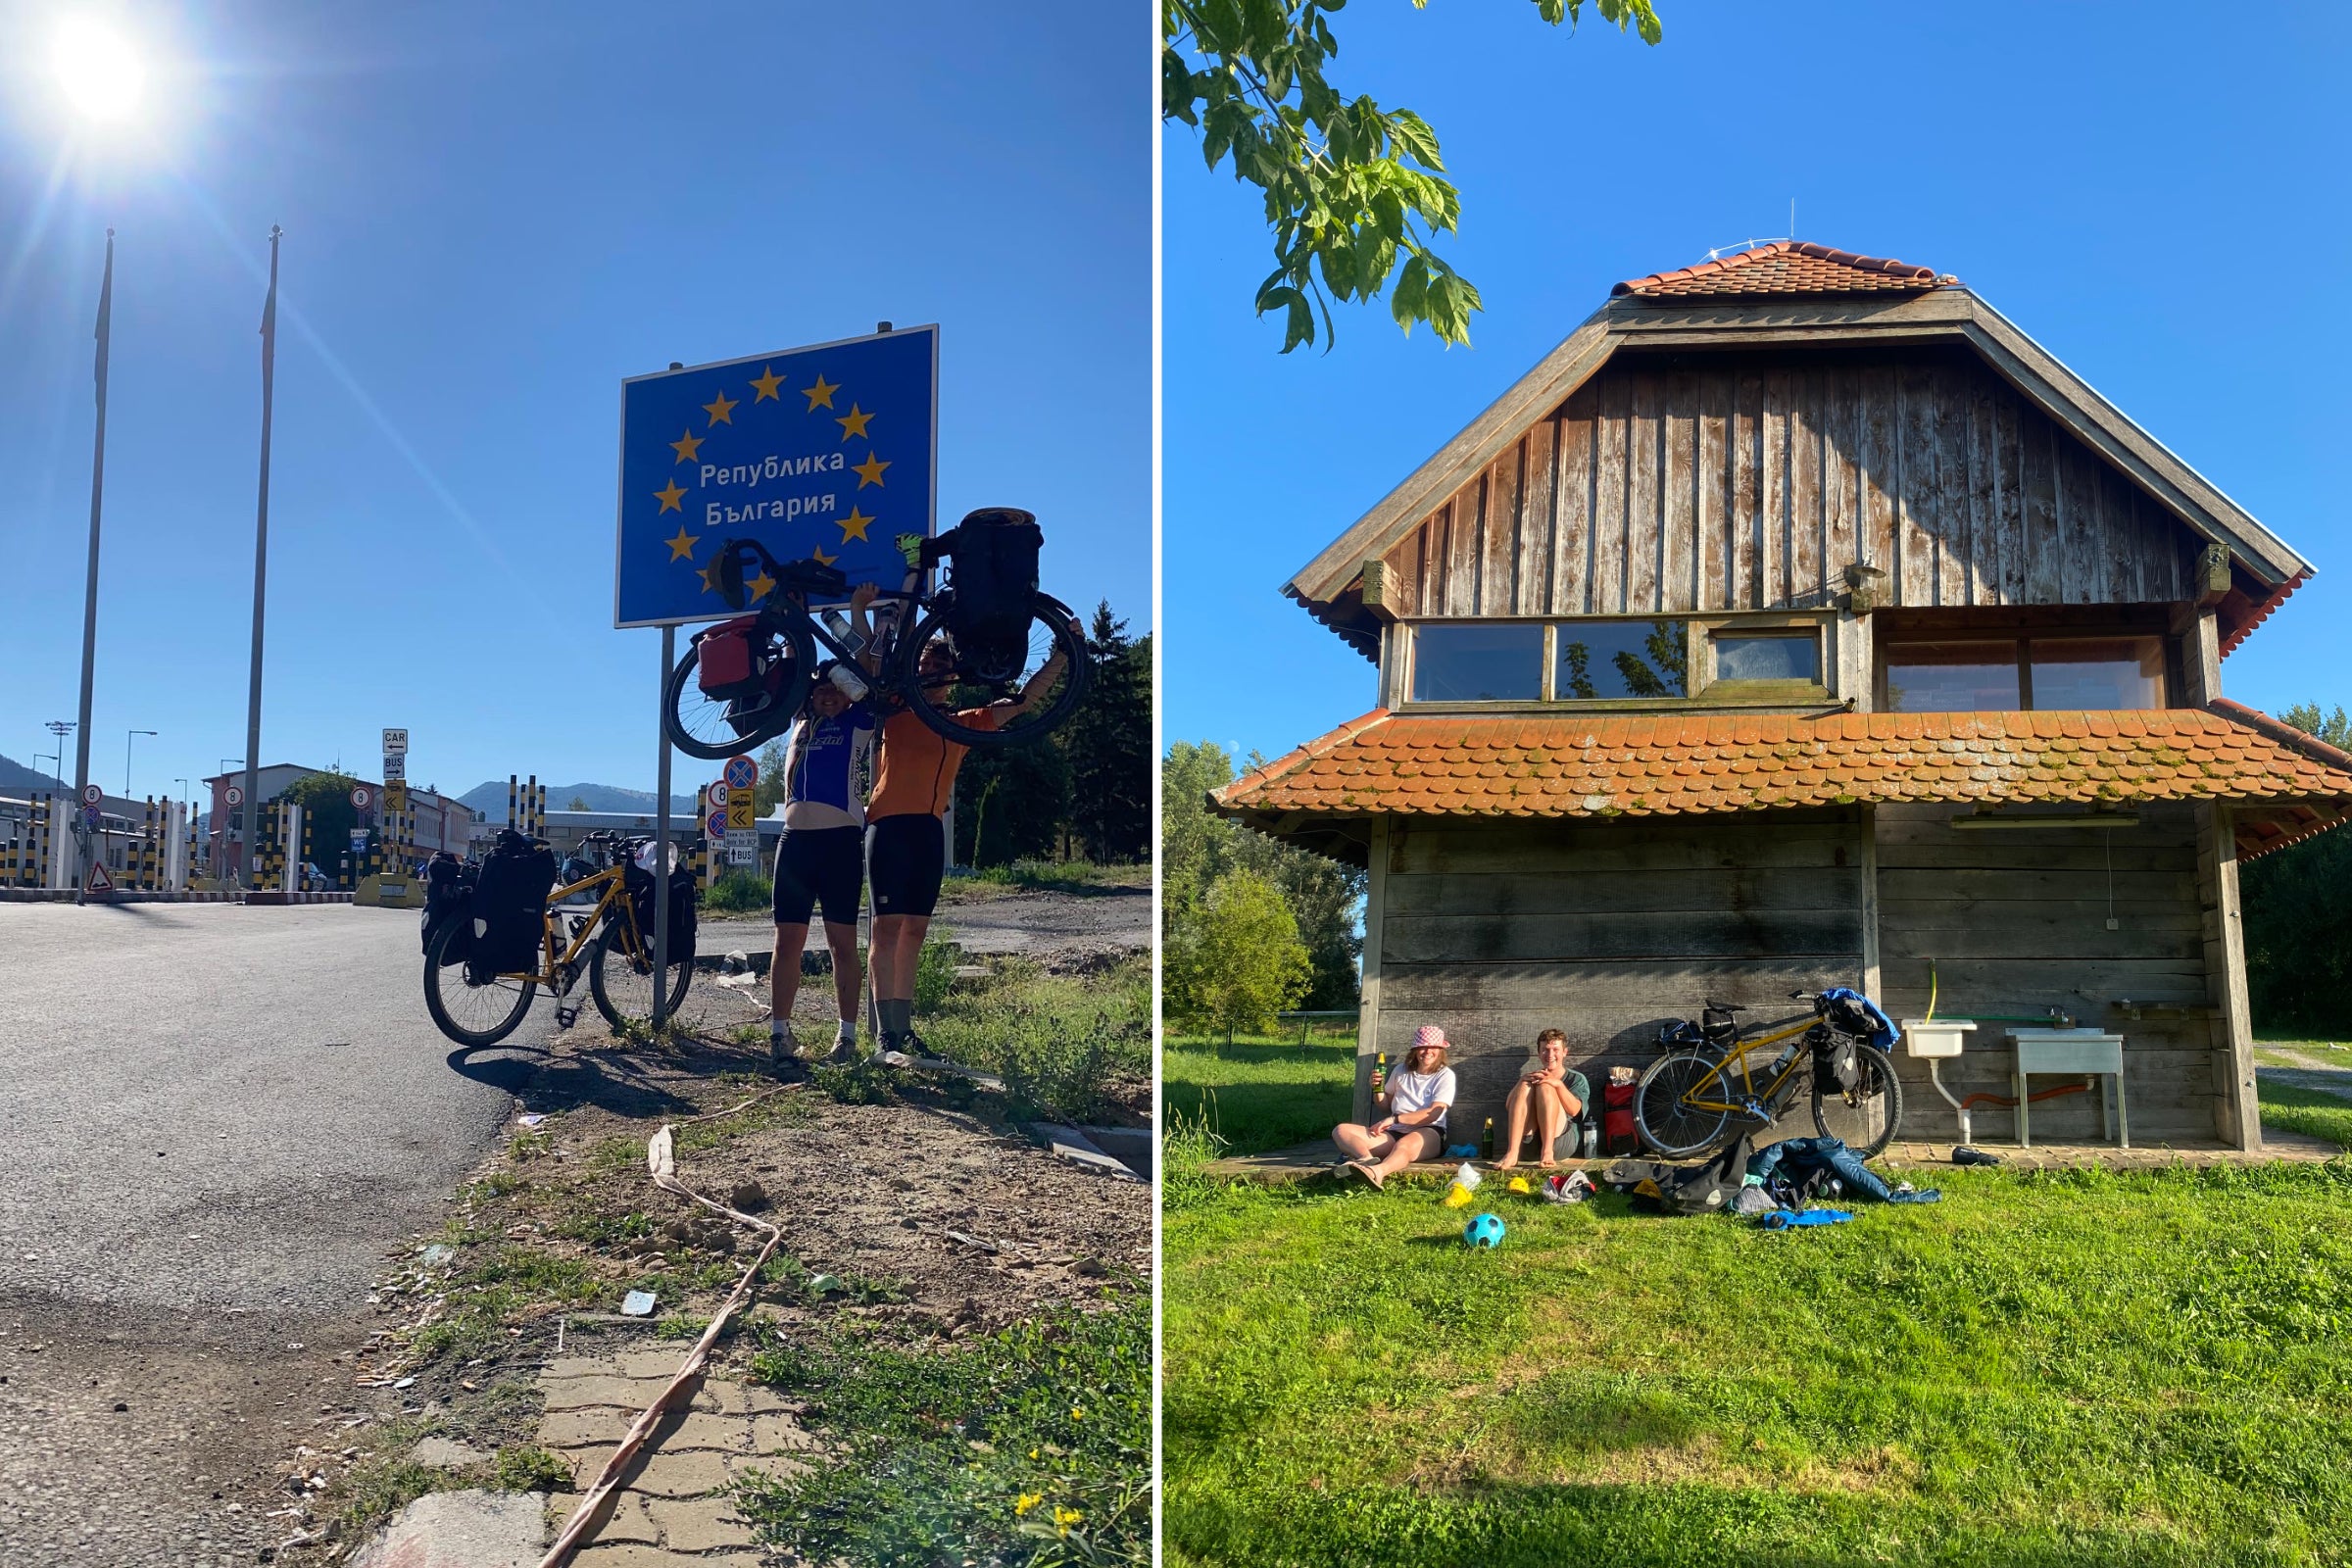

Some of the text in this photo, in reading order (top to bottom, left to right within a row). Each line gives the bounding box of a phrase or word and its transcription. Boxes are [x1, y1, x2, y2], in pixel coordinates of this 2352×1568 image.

[700, 452, 844, 488] Република
[706, 493, 835, 526] България
[384, 733, 405, 742] CAR
[385, 758, 403, 767] BUS
[89, 789, 95, 799] 8
[230, 791, 235, 802] 8
[358, 792, 364, 803] 8
[718, 787, 726, 802] 8
[737, 851, 752, 859] BUS
